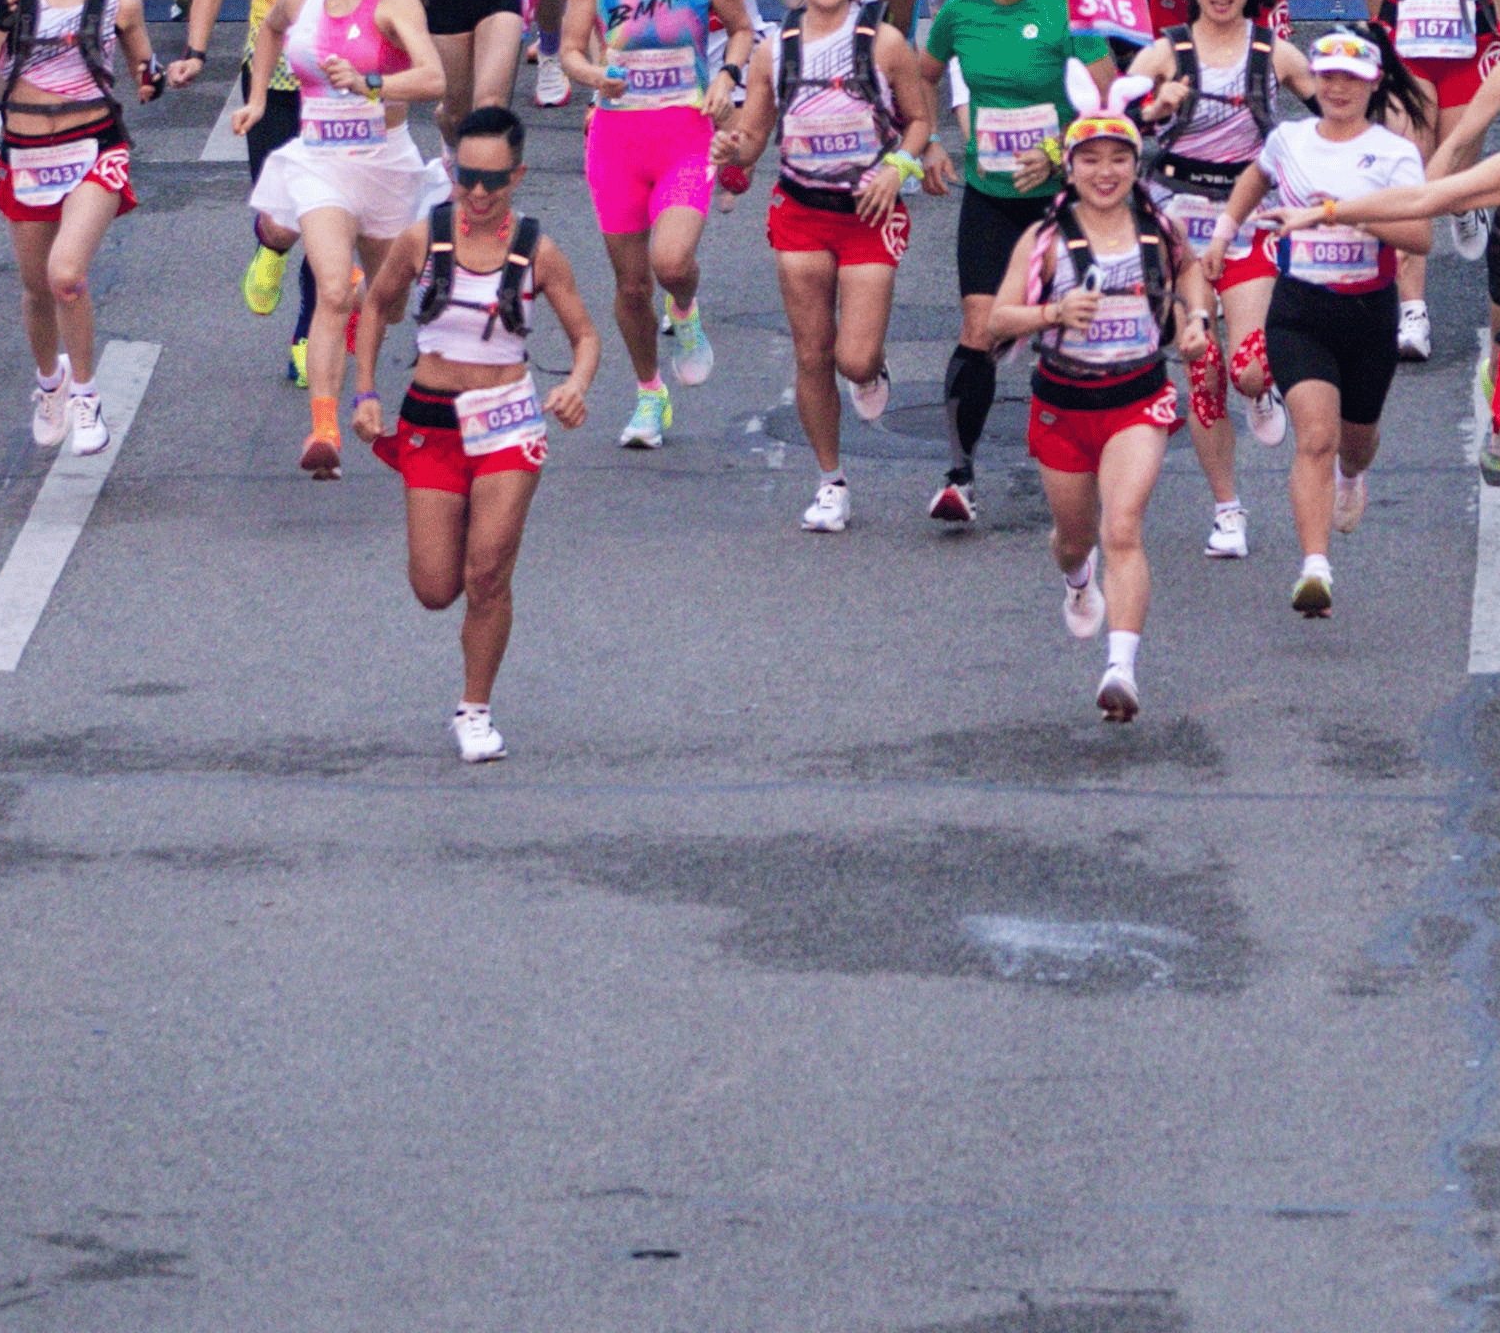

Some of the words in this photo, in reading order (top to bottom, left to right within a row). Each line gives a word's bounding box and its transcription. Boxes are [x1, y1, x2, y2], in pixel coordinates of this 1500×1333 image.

[1417, 19, 1459, 37] 1671
[633, 69, 678, 88] 0371
[324, 121, 368, 139] 1076
[811, 134, 858, 153] 1682
[996, 131, 1040, 150] 1105
[1312, 242, 1363, 262] 0897
[1086, 321, 1137, 342] 0528
[487, 398, 536, 429] 0534
